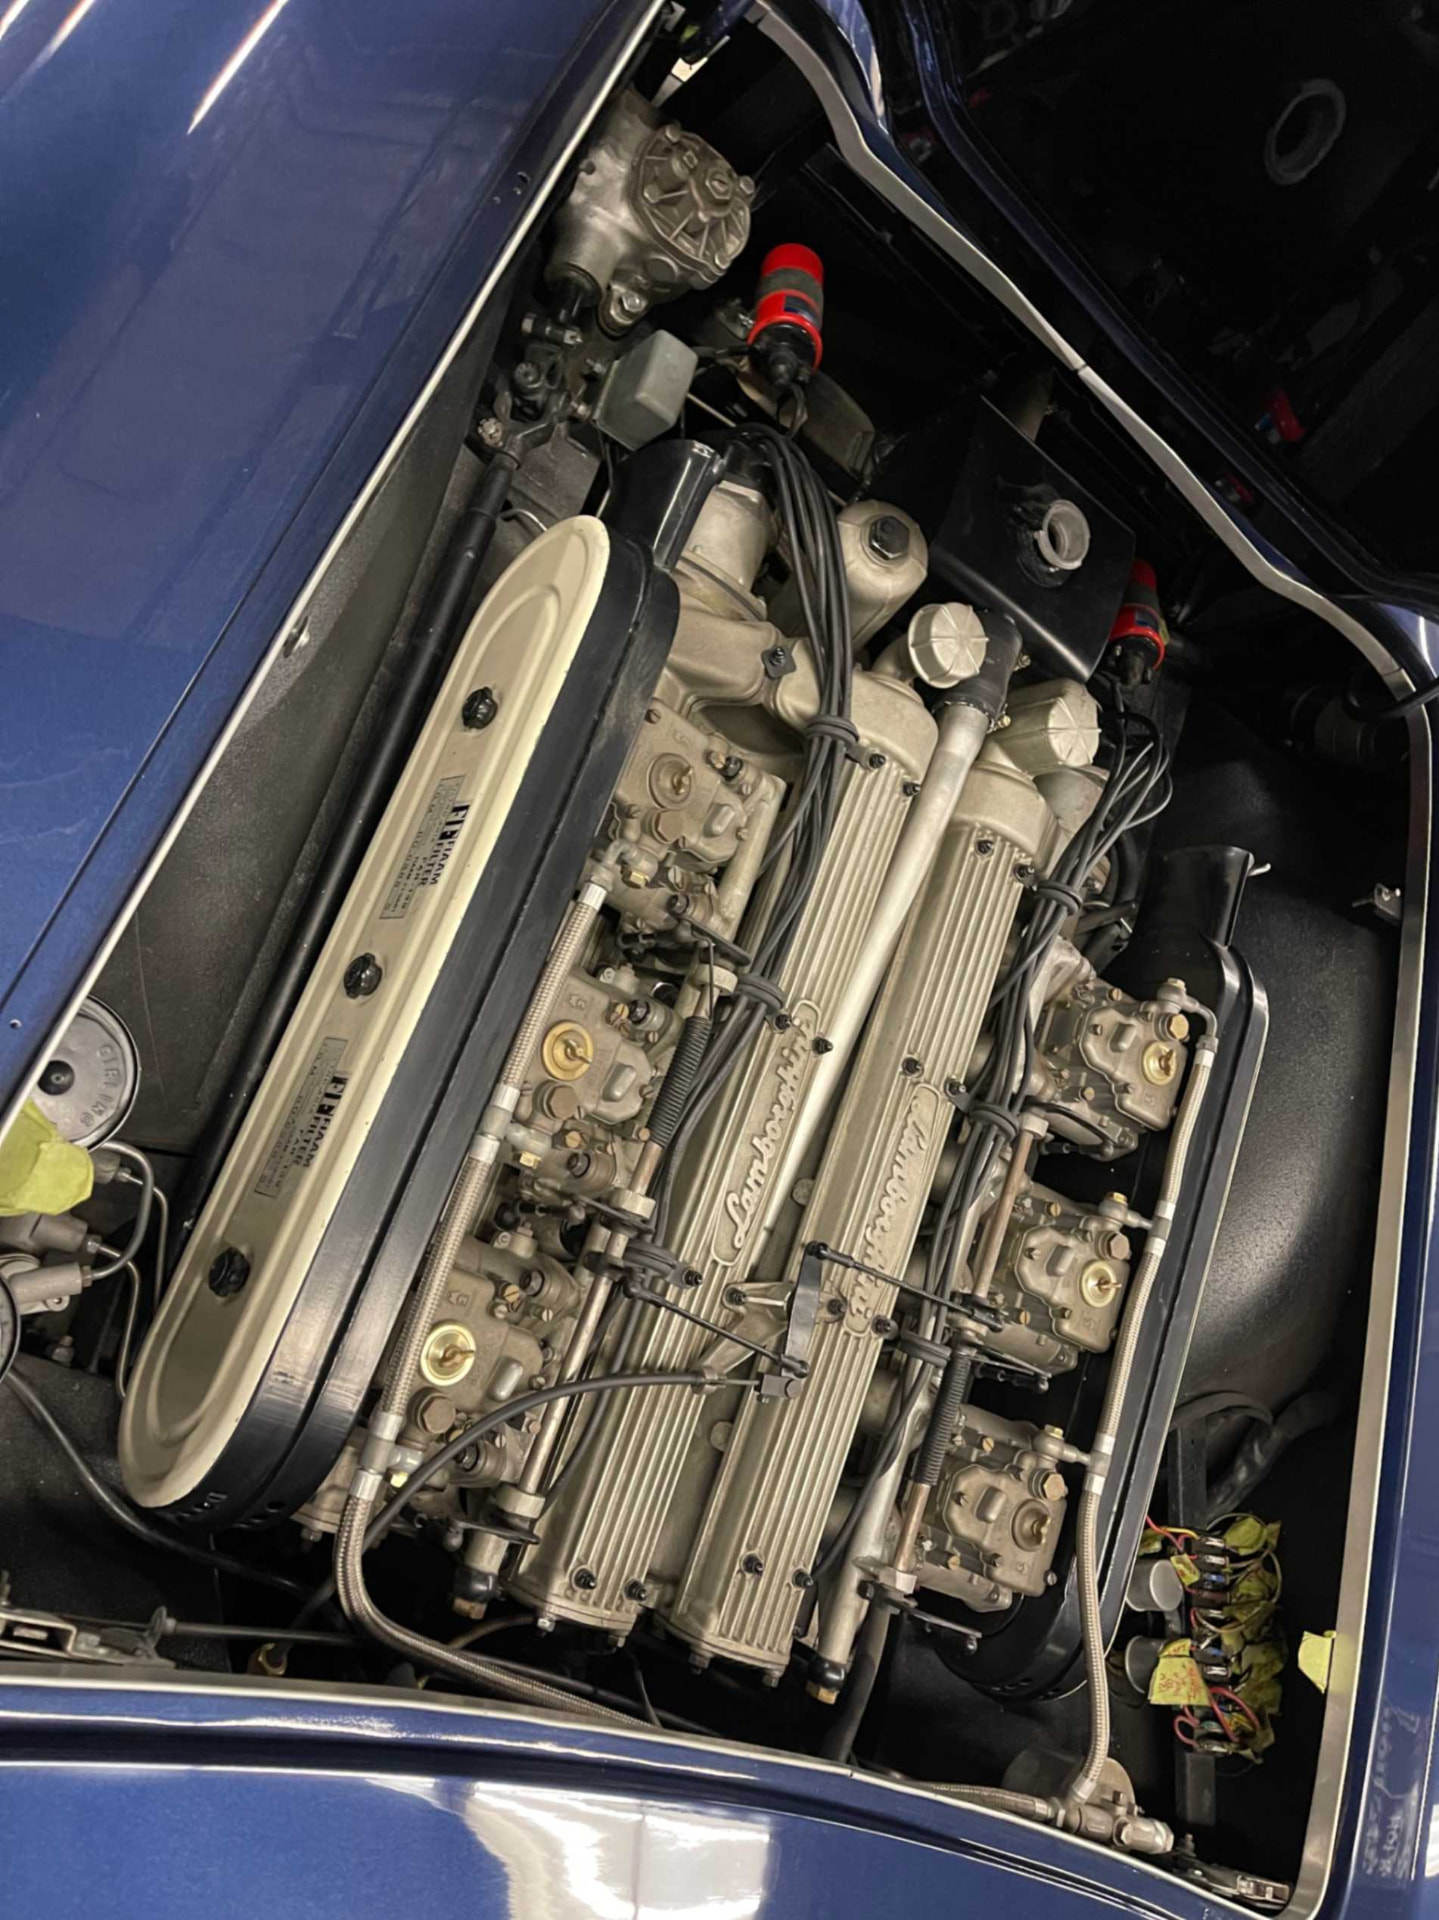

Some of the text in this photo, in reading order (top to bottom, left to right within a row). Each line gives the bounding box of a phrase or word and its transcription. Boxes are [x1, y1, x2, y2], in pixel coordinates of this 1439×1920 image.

[418, 842, 444, 886] FILTER
[429, 840, 455, 885] FIAAM
[292, 1116, 321, 1167] FILTER
[303, 1117, 331, 1168] FIAAM
[726, 1017, 813, 1249] Lamborghini
[850, 1096, 927, 1318] Lamborghini
